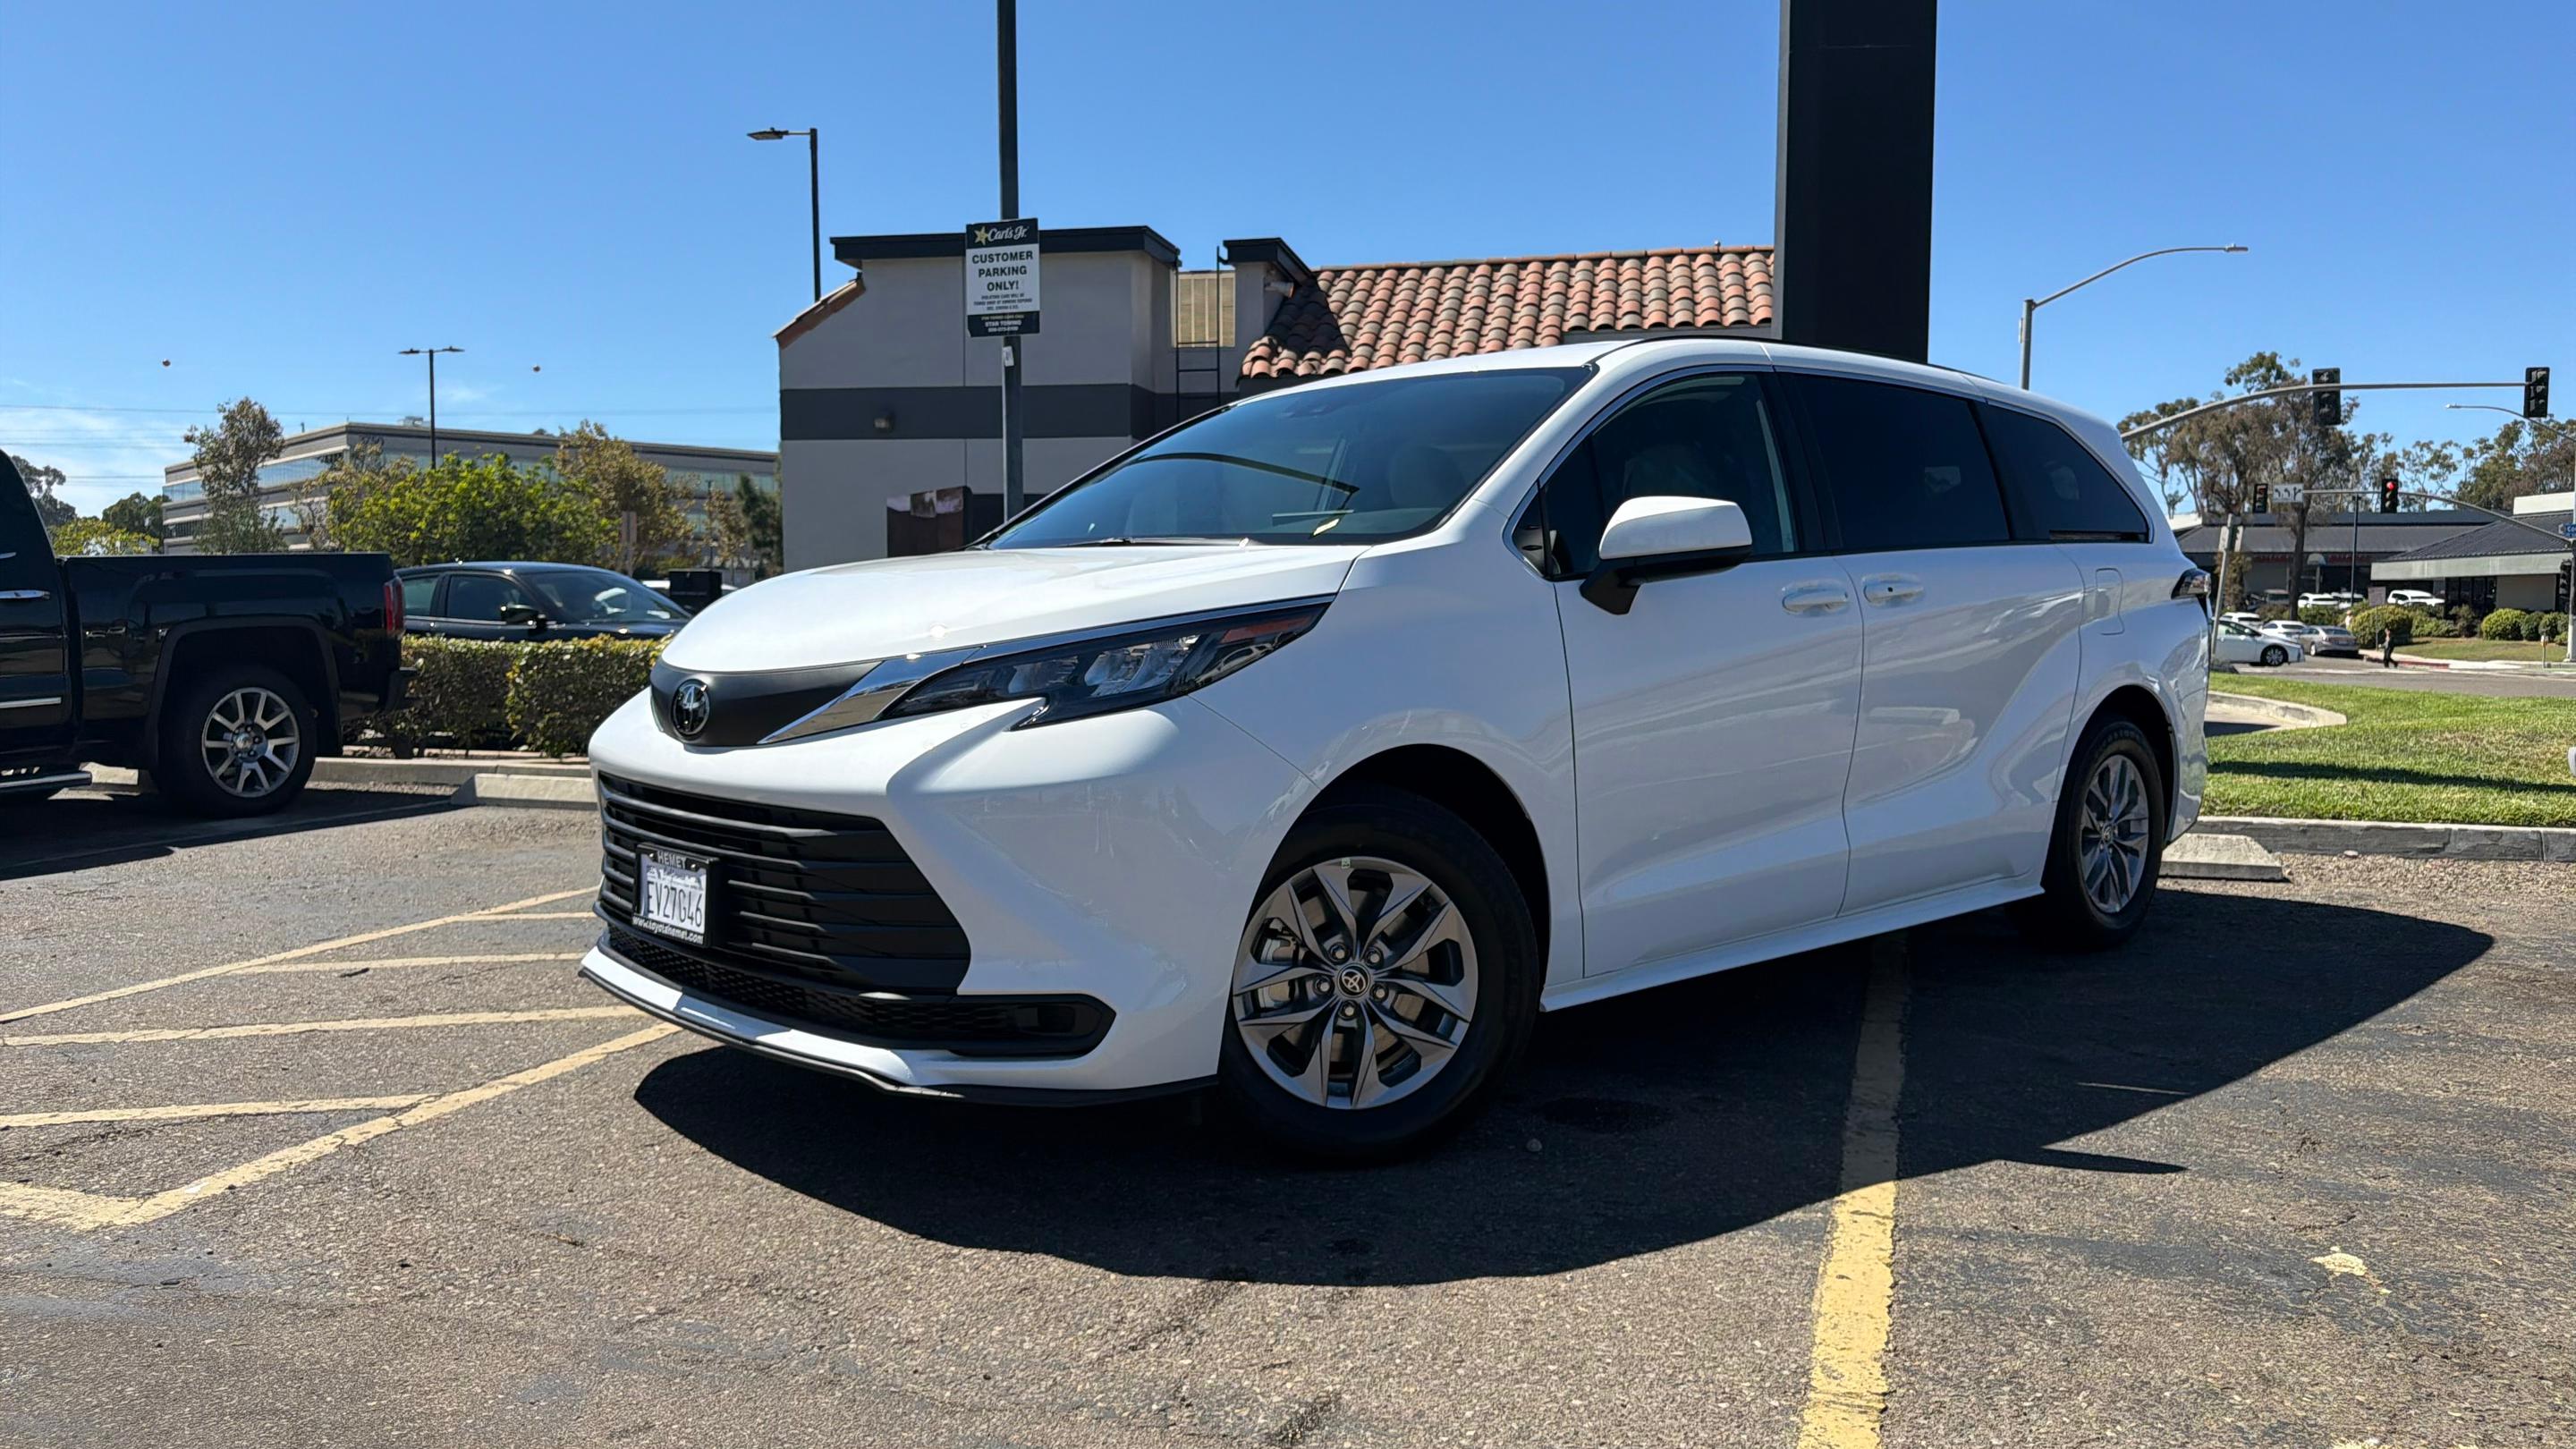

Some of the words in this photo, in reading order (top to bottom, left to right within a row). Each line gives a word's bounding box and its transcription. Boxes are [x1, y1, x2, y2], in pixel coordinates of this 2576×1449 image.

[987, 227, 1013, 242] Carl's
[972, 250, 1033, 264] CUSTOMER
[979, 266, 1027, 277] PARKING
[987, 280, 1019, 292] ONLY!
[657, 851, 686, 869] HEMET
[648, 881, 702, 928] EV27G46
